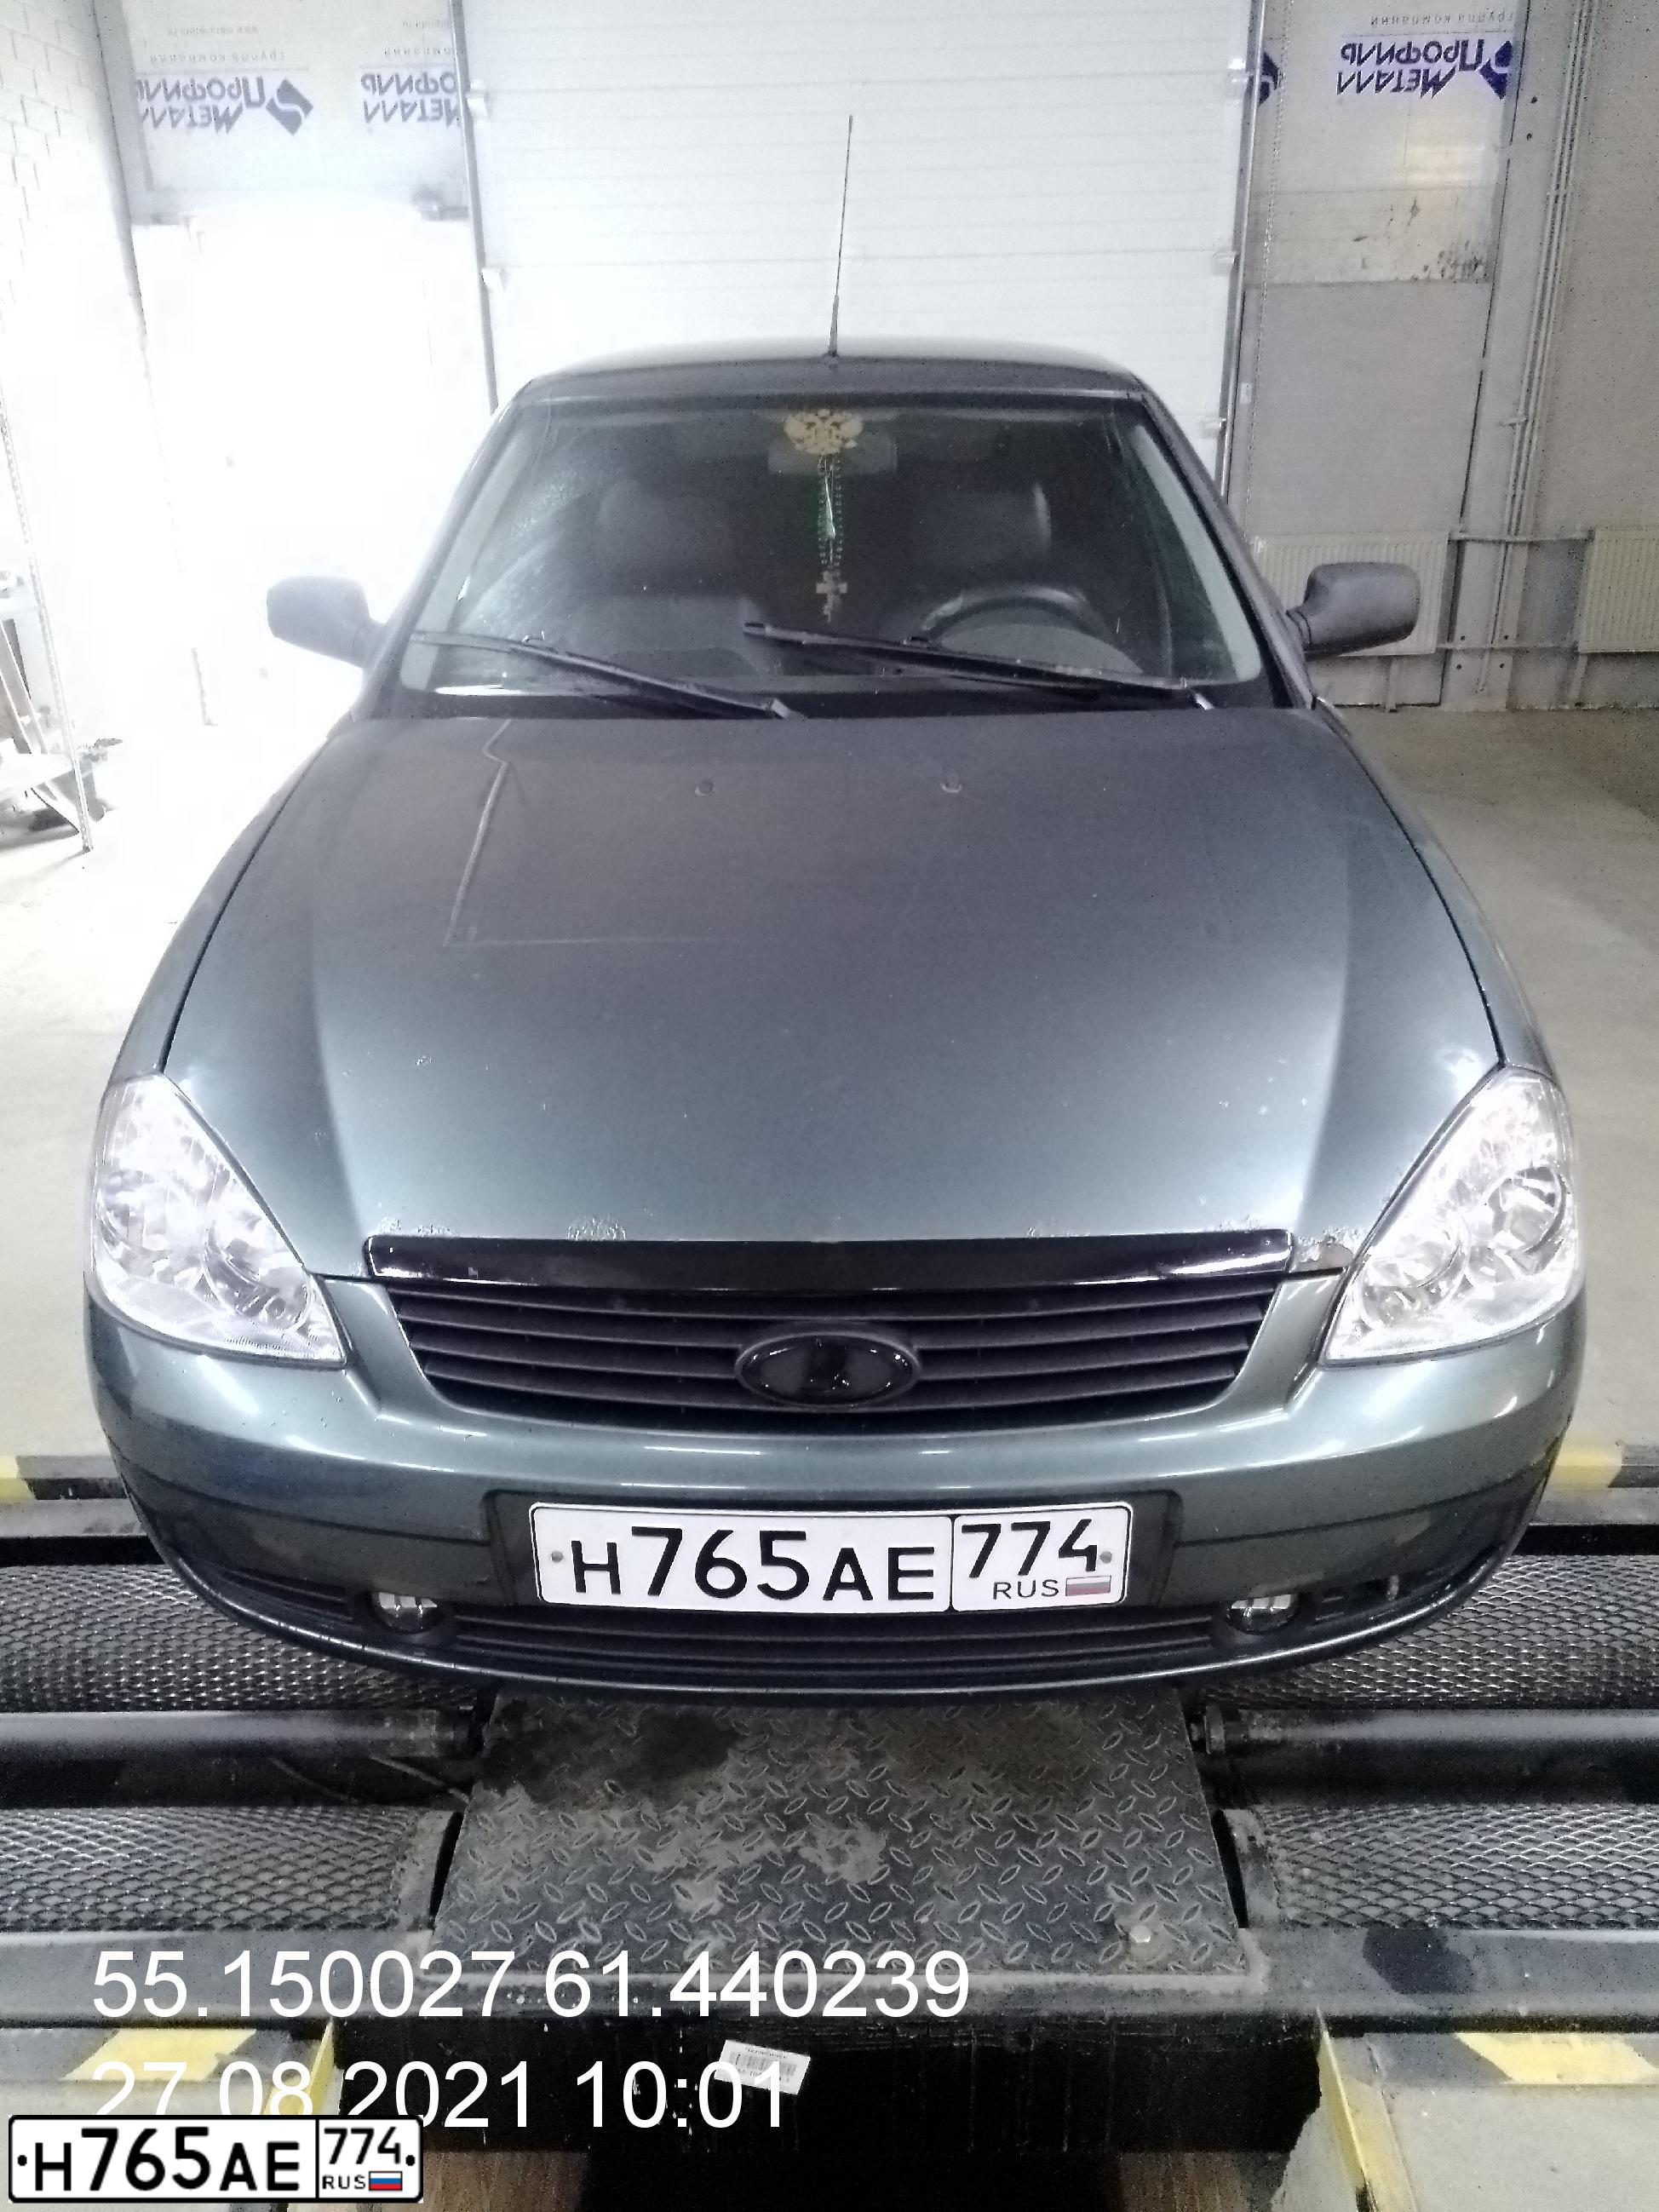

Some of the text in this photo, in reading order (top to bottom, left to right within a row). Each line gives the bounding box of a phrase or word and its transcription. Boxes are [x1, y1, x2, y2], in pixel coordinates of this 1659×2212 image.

[1340, 39, 1484, 71] ПРОФИЛЬ
[360, 72, 457, 101] ОФИЛЬ
[1337, 65, 1456, 99] МЕТАЛЛ
[962, 1520, 1098, 1578] 774
[993, 1580, 1059, 1600] RUS
